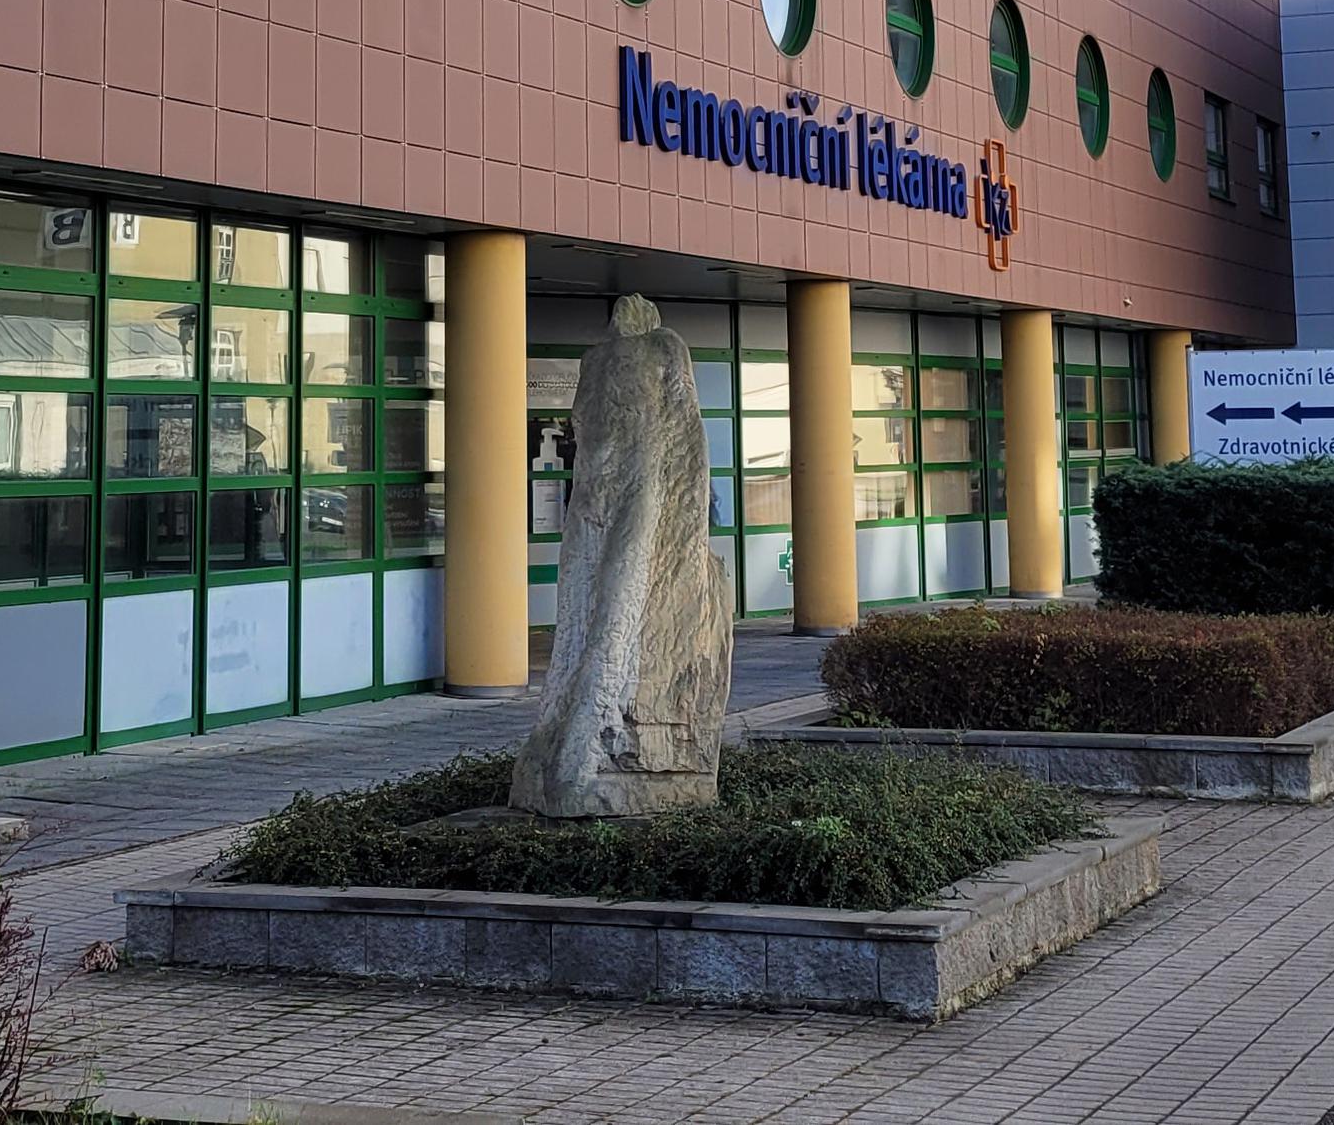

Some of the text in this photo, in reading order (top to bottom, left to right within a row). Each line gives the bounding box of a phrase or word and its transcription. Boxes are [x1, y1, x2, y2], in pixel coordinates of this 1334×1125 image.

[619, 45, 853, 191] Nemocniční
[856, 111, 969, 219] lékárna
[1203, 368, 1313, 387] Nemocniční
